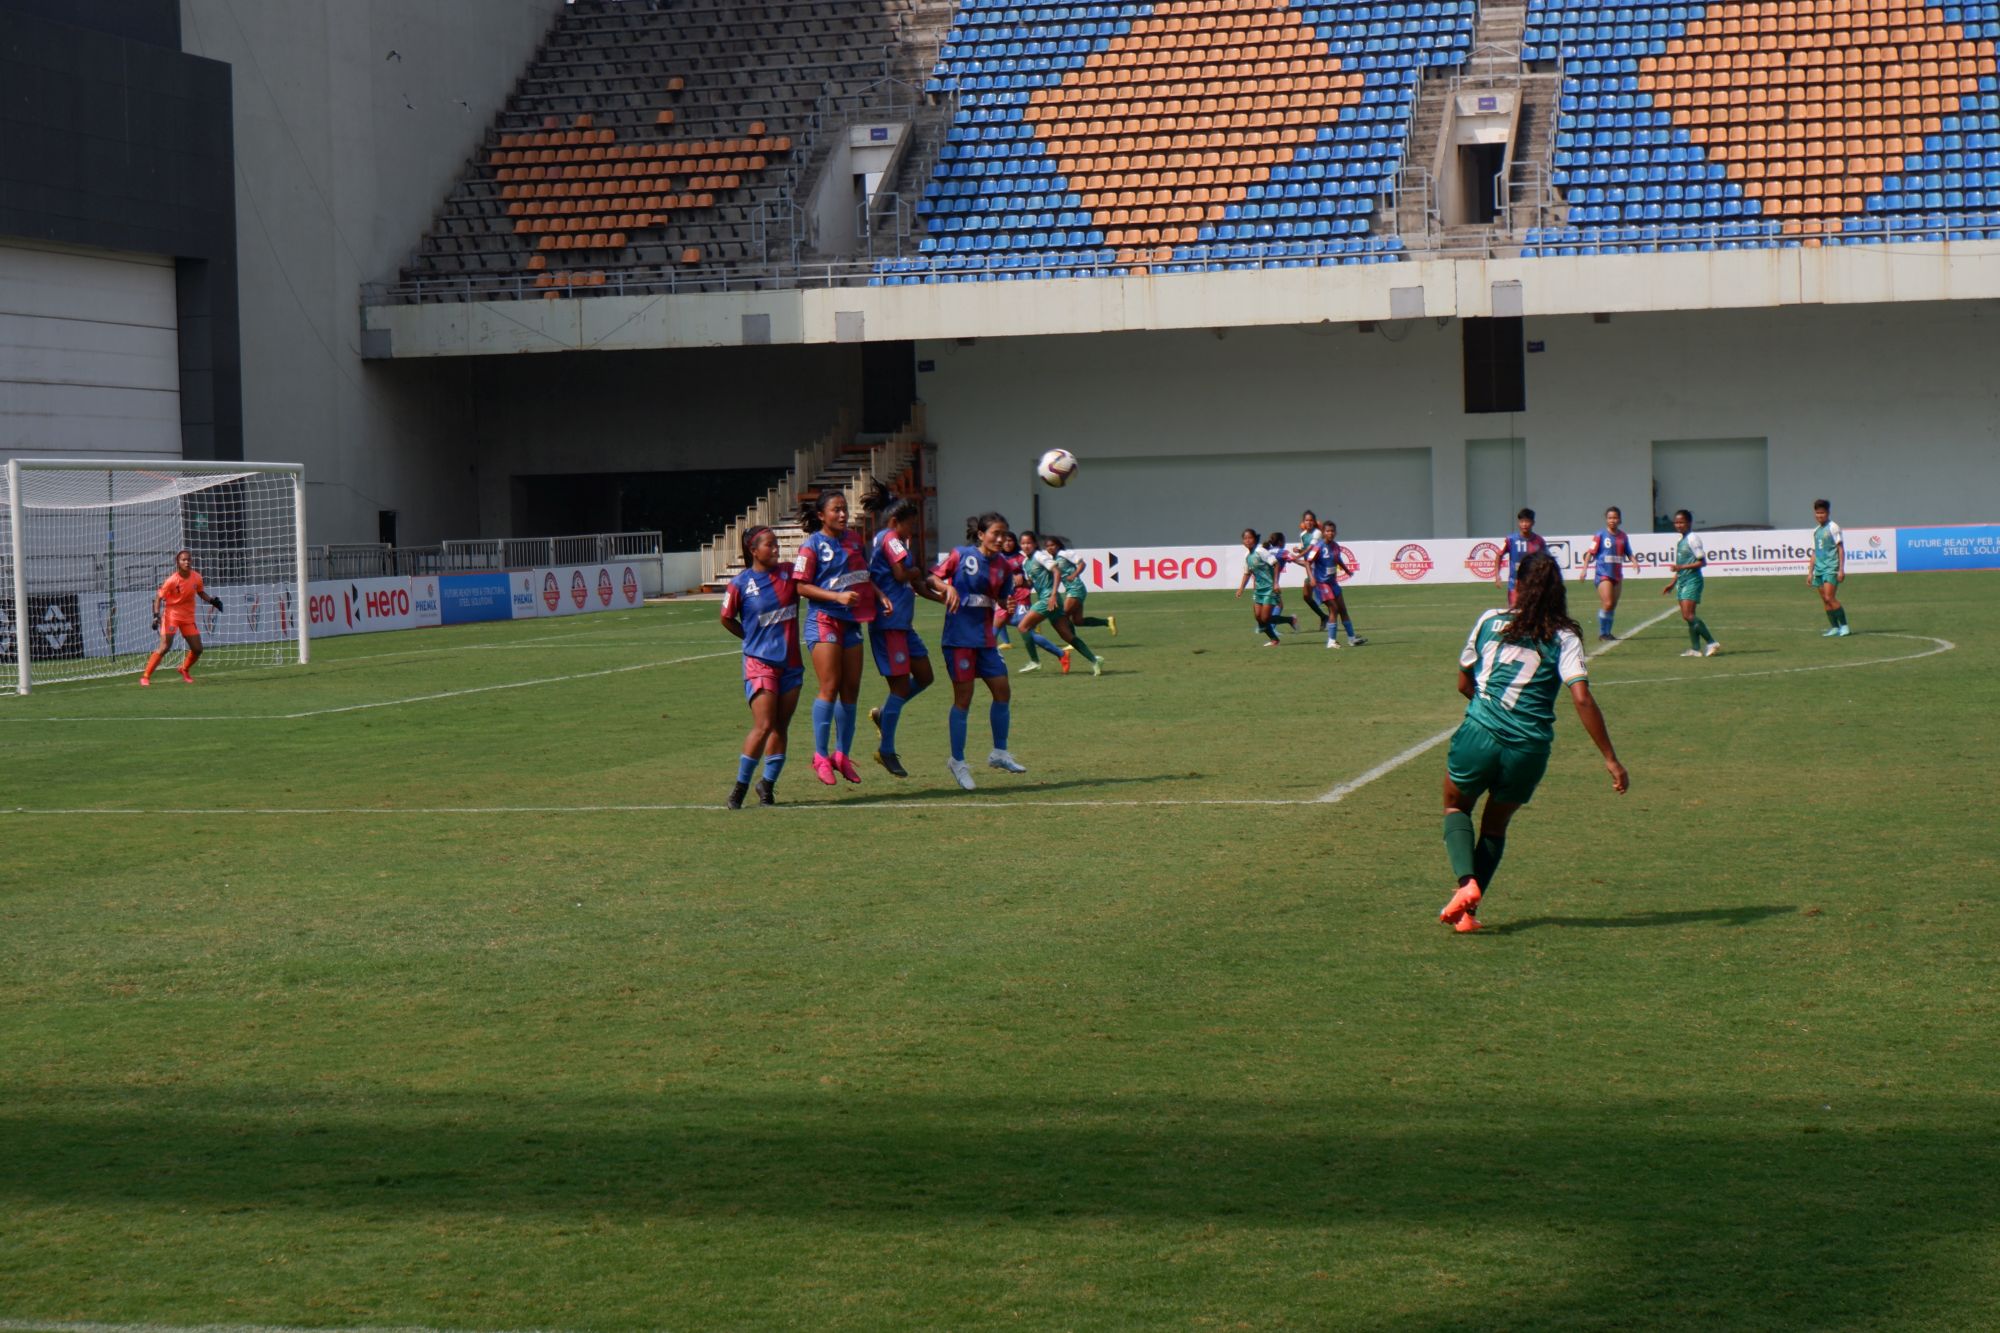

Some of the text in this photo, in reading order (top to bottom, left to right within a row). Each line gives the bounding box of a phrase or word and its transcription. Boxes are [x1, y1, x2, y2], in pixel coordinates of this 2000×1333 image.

[818, 541, 834, 563] 3
[1322, 547, 1330, 559] 2
[1515, 540, 1527, 552] 11
[1604, 537, 1612, 549] 6
[1818, 539, 1823, 550] 2
[1943, 547, 1970, 556] STEEL
[1635, 545, 1747, 567] equients
[1846, 549, 1887, 560] HENIX
[965, 555, 979, 576] 9
[1133, 557, 1218, 580] Hero
[745, 577, 760, 596] 4
[308, 593, 336, 624] ero
[365, 588, 410, 618] Hero
[1475, 640, 1542, 711] 17
